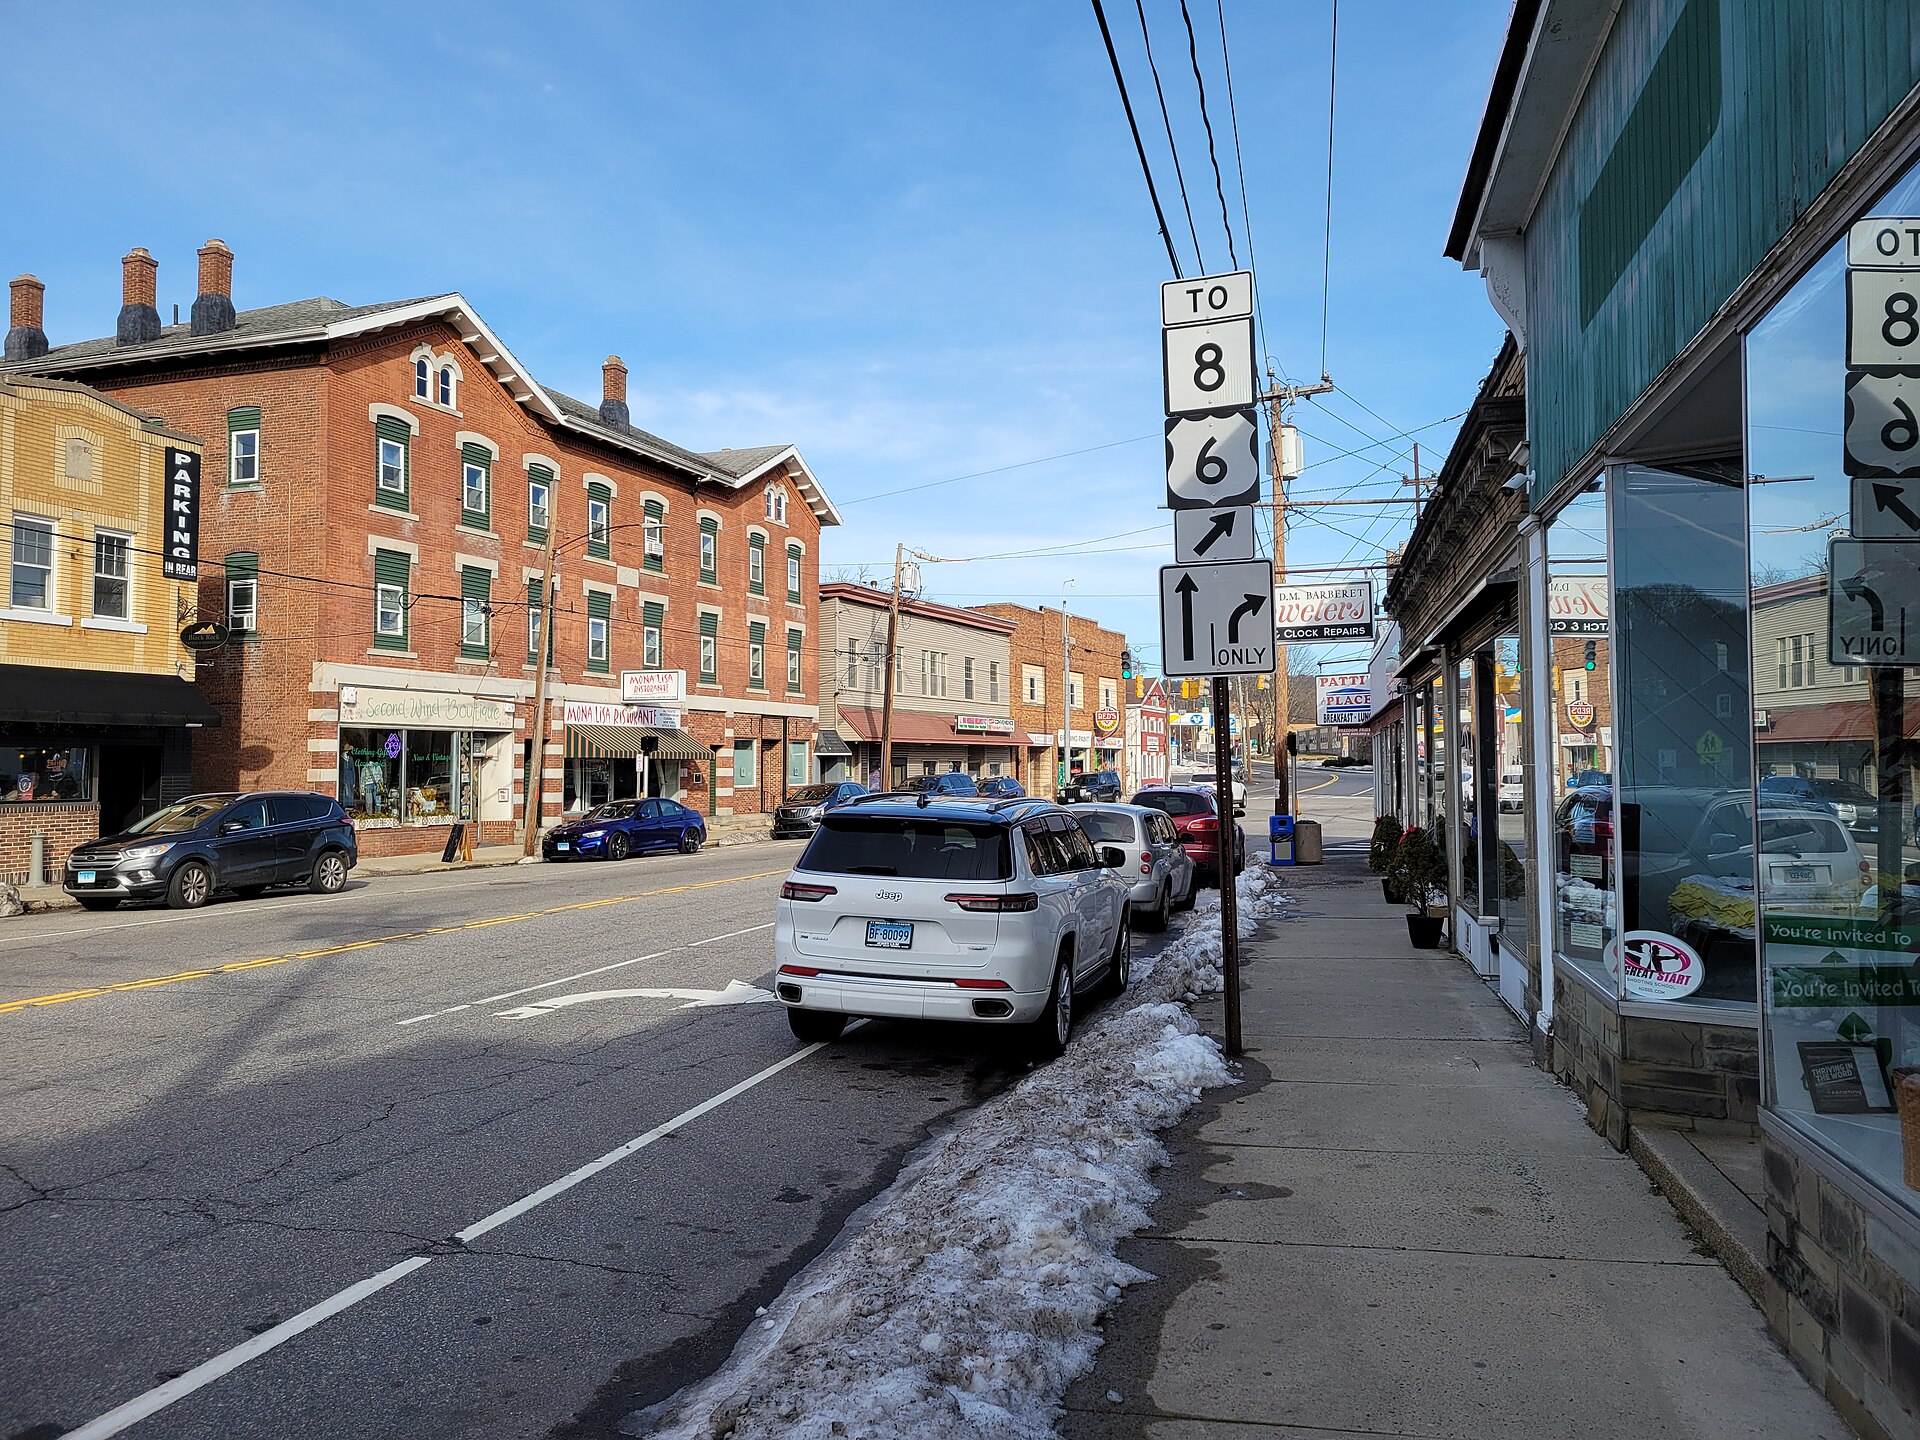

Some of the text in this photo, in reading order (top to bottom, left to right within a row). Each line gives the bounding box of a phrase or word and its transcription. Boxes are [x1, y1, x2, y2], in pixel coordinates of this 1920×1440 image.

[1186, 286, 1228, 313] TO
[1194, 342, 1226, 392] 8
[1196, 436, 1228, 484] 6
[172, 452, 192, 559] PARKING
[165, 561, 196, 576] IN REAR
[1280, 588, 1364, 600] D.M. BARBERET
[1284, 629, 1318, 638] CLOCK
[1324, 627, 1366, 636] REPAIRS
[1218, 648, 1266, 666] ONLY
[630, 674, 654, 684] MONA
[1320, 676, 1369, 687] PATTI'
[1326, 695, 1370, 706] PLACE
[366, 697, 500, 722] Second Wind Boutique
[566, 705, 594, 722] MONA
[1324, 713, 1354, 724] BREAKFAST
[875, 889, 902, 902] Jeep
[1770, 924, 1912, 946] You're Invited To
[1624, 966, 1655, 979] GREAT
[1656, 972, 1692, 986] START
[1627, 977, 1676, 990] SHOOTING SCHOOL
[1780, 980, 1838, 998] You're
[1844, 980, 1904, 998] Invited
[1811, 1062, 1854, 1076] THRIVING IN
[1816, 1070, 1852, 1082] THE WORD
